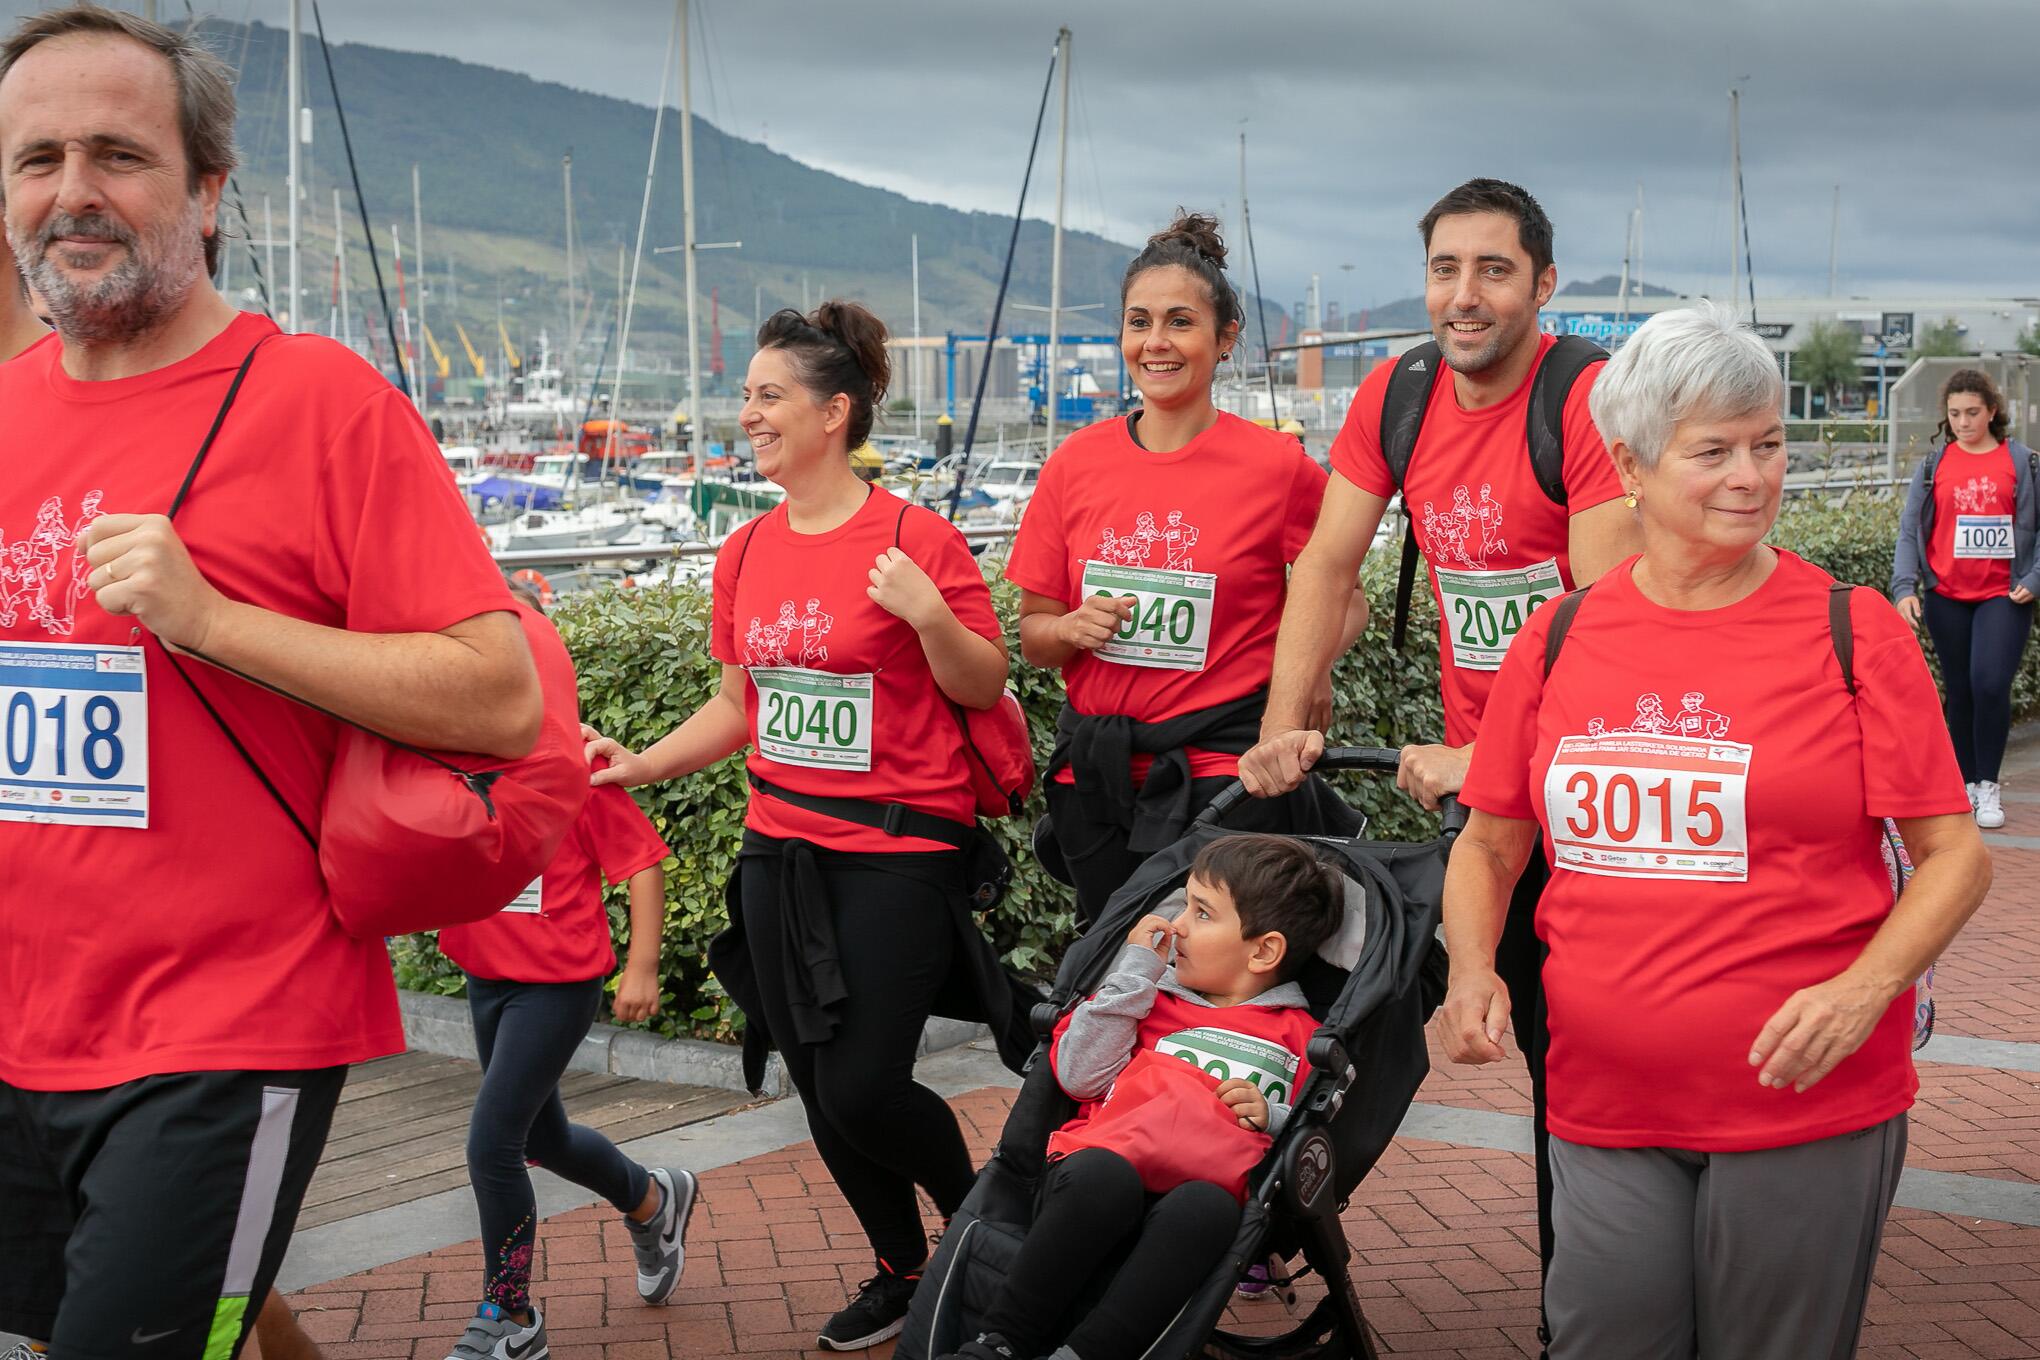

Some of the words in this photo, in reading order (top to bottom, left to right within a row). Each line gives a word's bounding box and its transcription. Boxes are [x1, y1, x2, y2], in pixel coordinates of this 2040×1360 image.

[1962, 528, 2009, 547] 1002
[6, 691, 124, 780] 018
[766, 691, 858, 747] 2040
[1565, 771, 1724, 847] 3015
